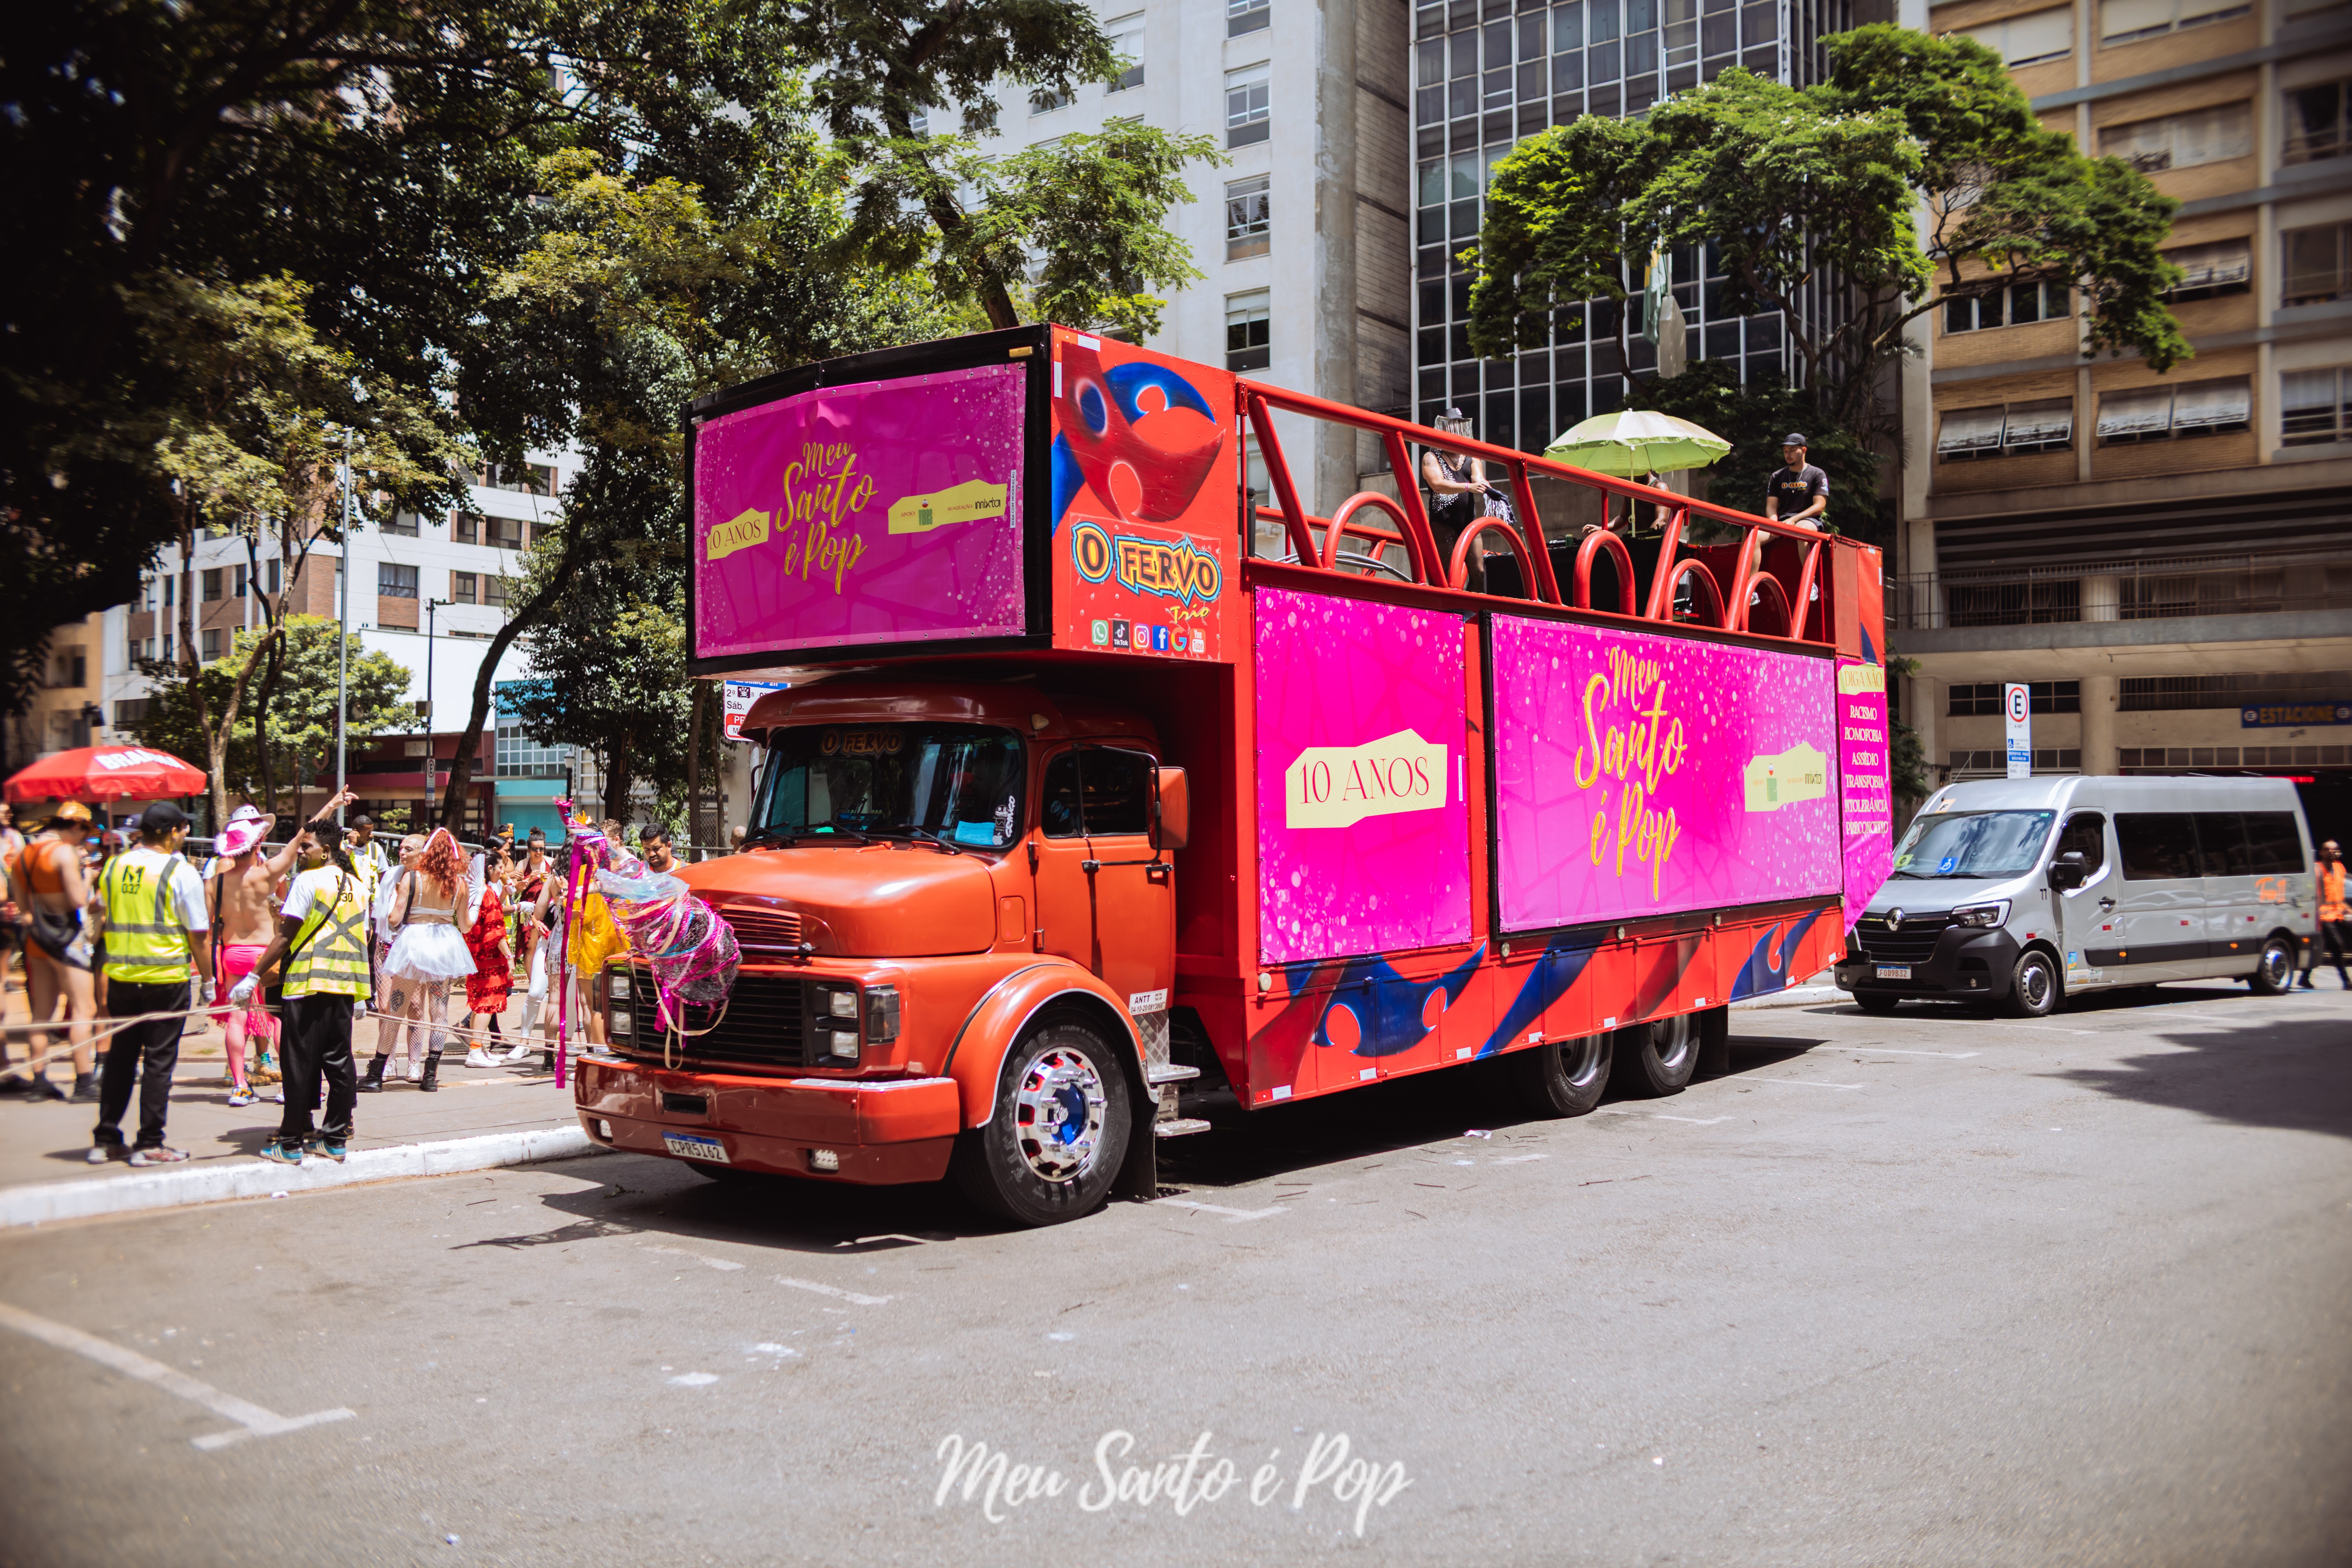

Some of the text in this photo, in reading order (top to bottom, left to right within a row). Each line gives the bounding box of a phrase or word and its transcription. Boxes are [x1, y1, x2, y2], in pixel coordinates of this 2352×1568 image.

[803, 442, 851, 478] Meu
[775, 454, 878, 528] Santo
[975, 497, 1000, 509] mixta
[709, 519, 761, 550] 10 ANOS
[785, 521, 867, 595] é Pop
[1077, 527, 1218, 597] O FERVO
[1171, 604, 1210, 624] Trio
[1193, 641, 1203, 650] Tube
[1610, 647, 1660, 710] Meu
[1844, 668, 1882, 687] DIGA NÃO
[727, 701, 744, 710] Sáb.
[1850, 705, 1877, 720] RACISMO
[2014, 695, 2022, 714] E
[822, 730, 902, 756] O FERVO
[1574, 681, 1687, 795] Santo
[1844, 727, 1883, 743] HOMOFOBIA
[1852, 750, 1878, 766] ASSÉDIO
[1300, 755, 1429, 804] 10 ANOS
[1805, 771, 1822, 784] mixta
[1845, 775, 1884, 788] TRANSFOBIA
[1844, 797, 1888, 813] INTOLERÂNCIA
[1005, 795, 1015, 838] GRINGO
[1846, 821, 1889, 835] PRECONCEITO
[1590, 781, 1681, 902] é Pop
[1135, 995, 1150, 1004] ANTT
